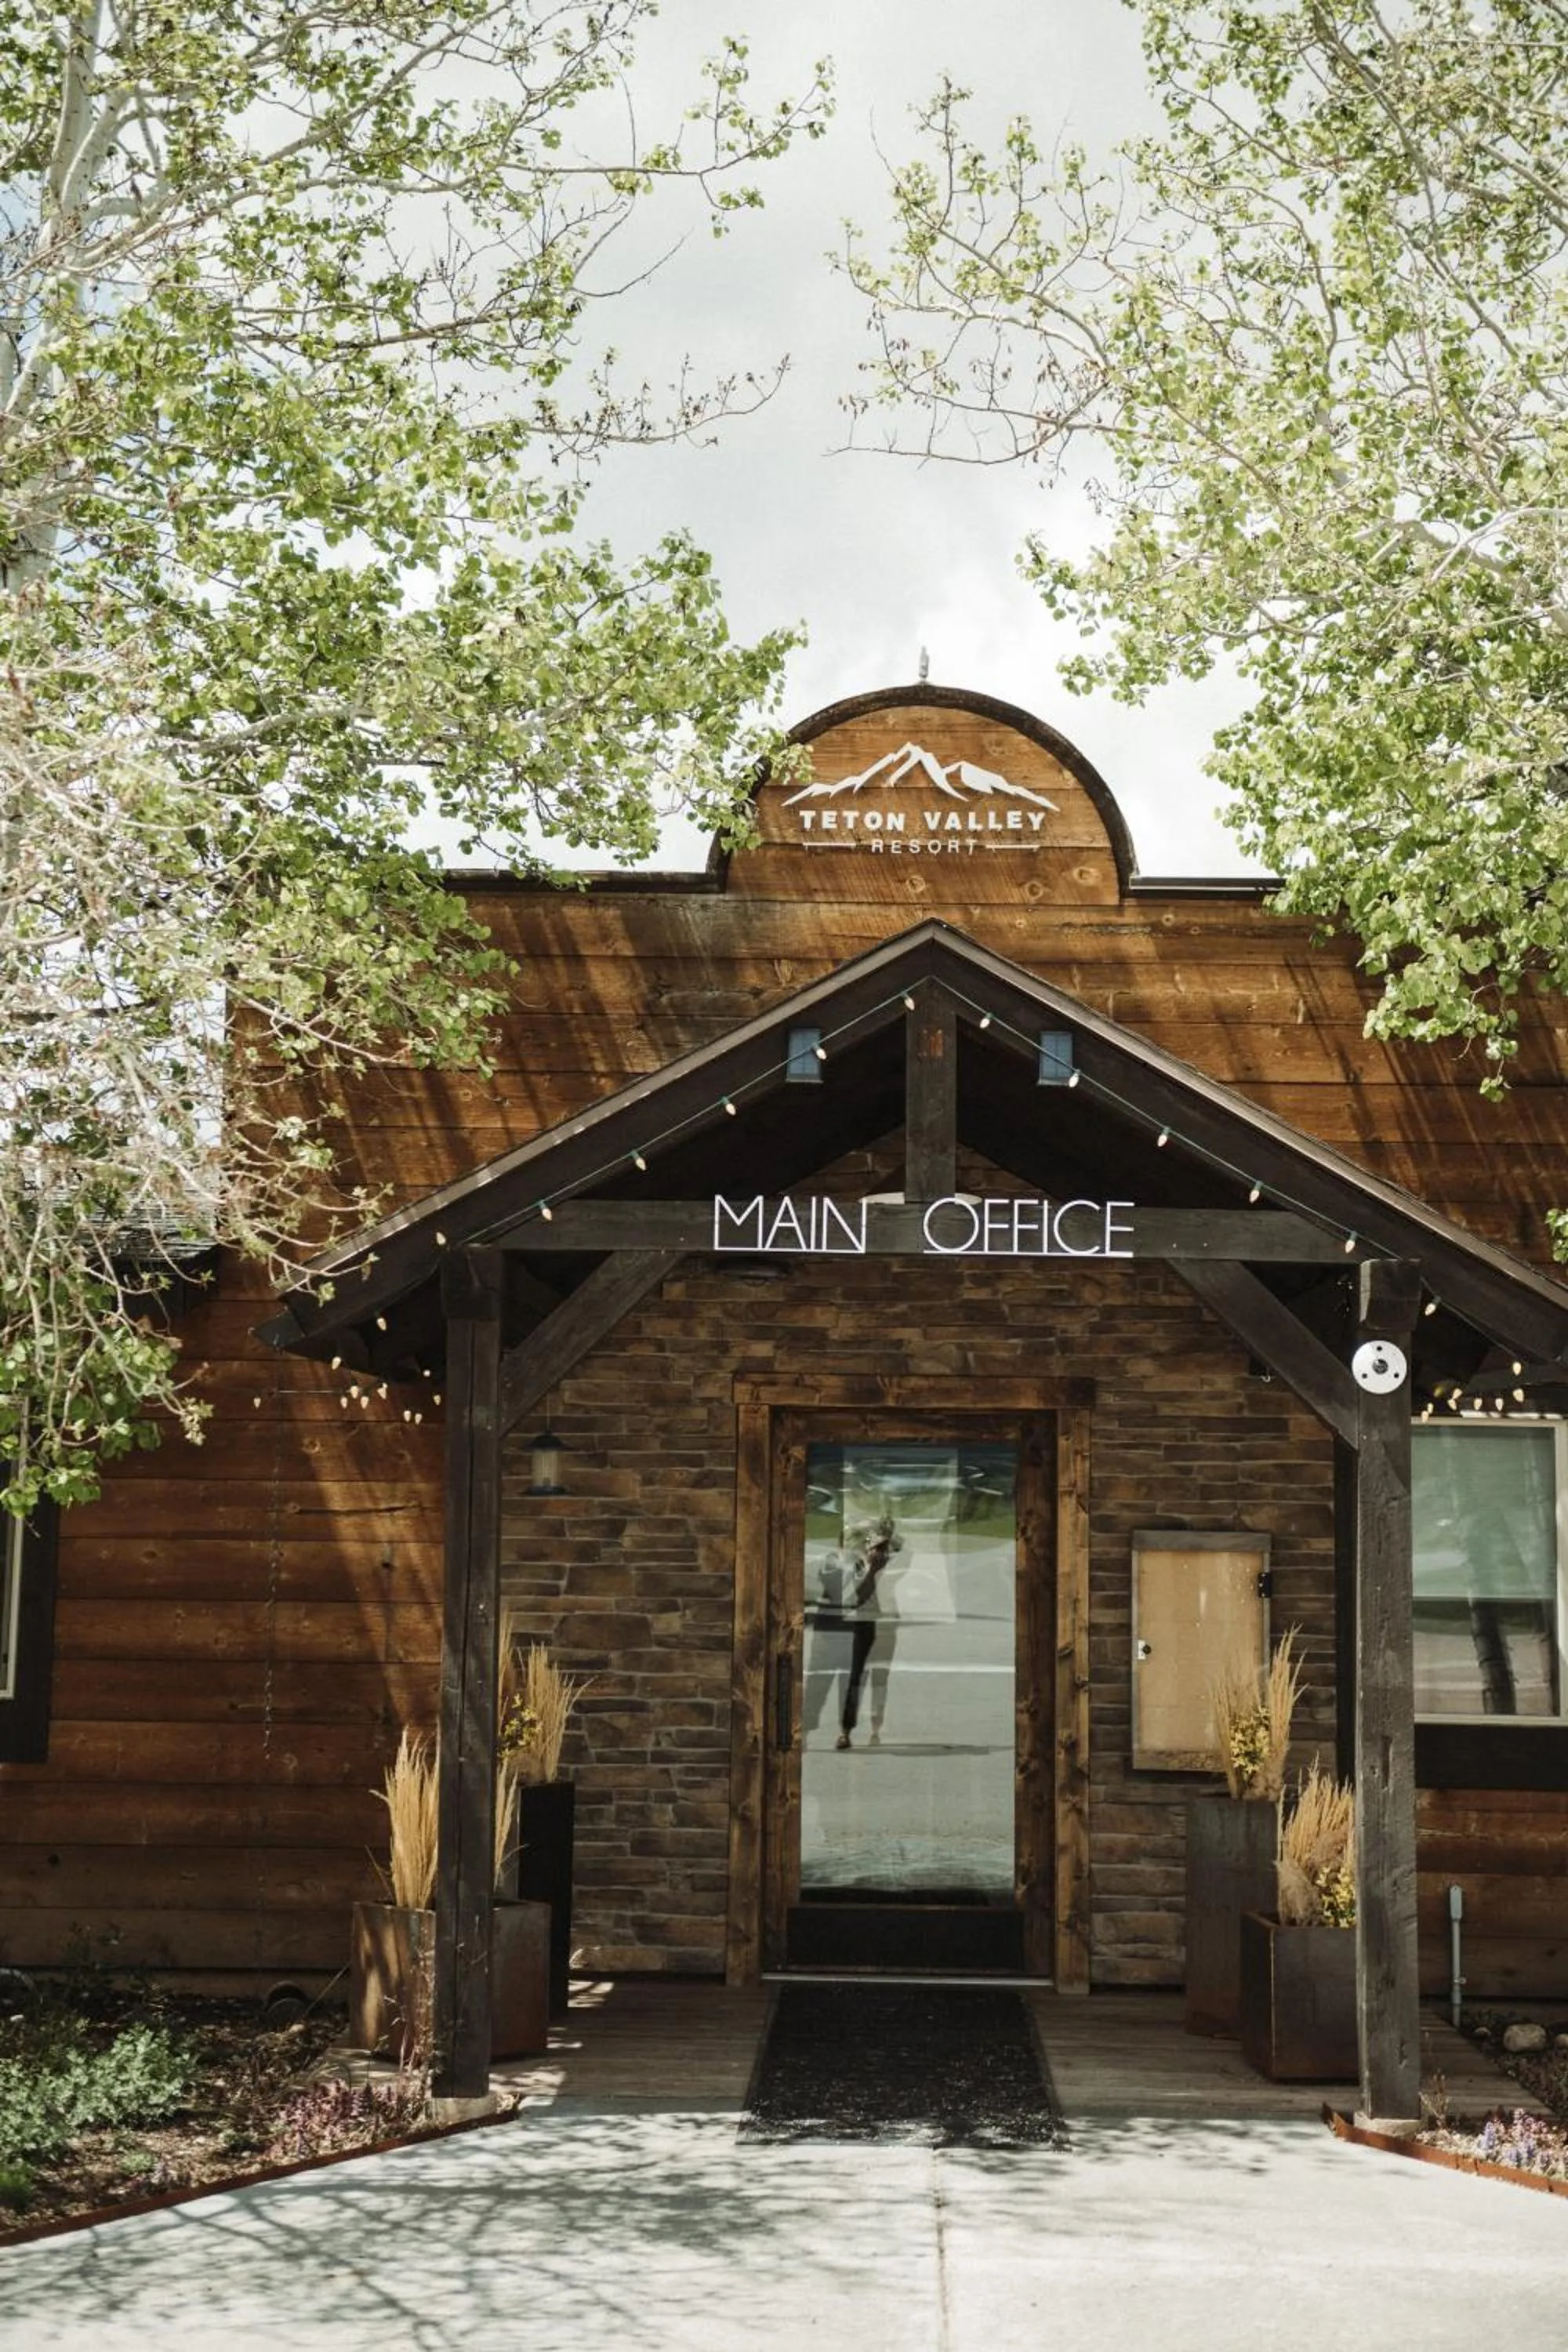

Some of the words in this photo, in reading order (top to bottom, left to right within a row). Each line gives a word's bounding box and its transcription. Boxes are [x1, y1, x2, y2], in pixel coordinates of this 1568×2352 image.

[799, 810, 906, 831] TETON
[924, 811, 1047, 831] VALLEY
[871, 840, 978, 855] RESORT
[714, 1194, 867, 1254] MAIN
[923, 1197, 1134, 1258] OFFICE
